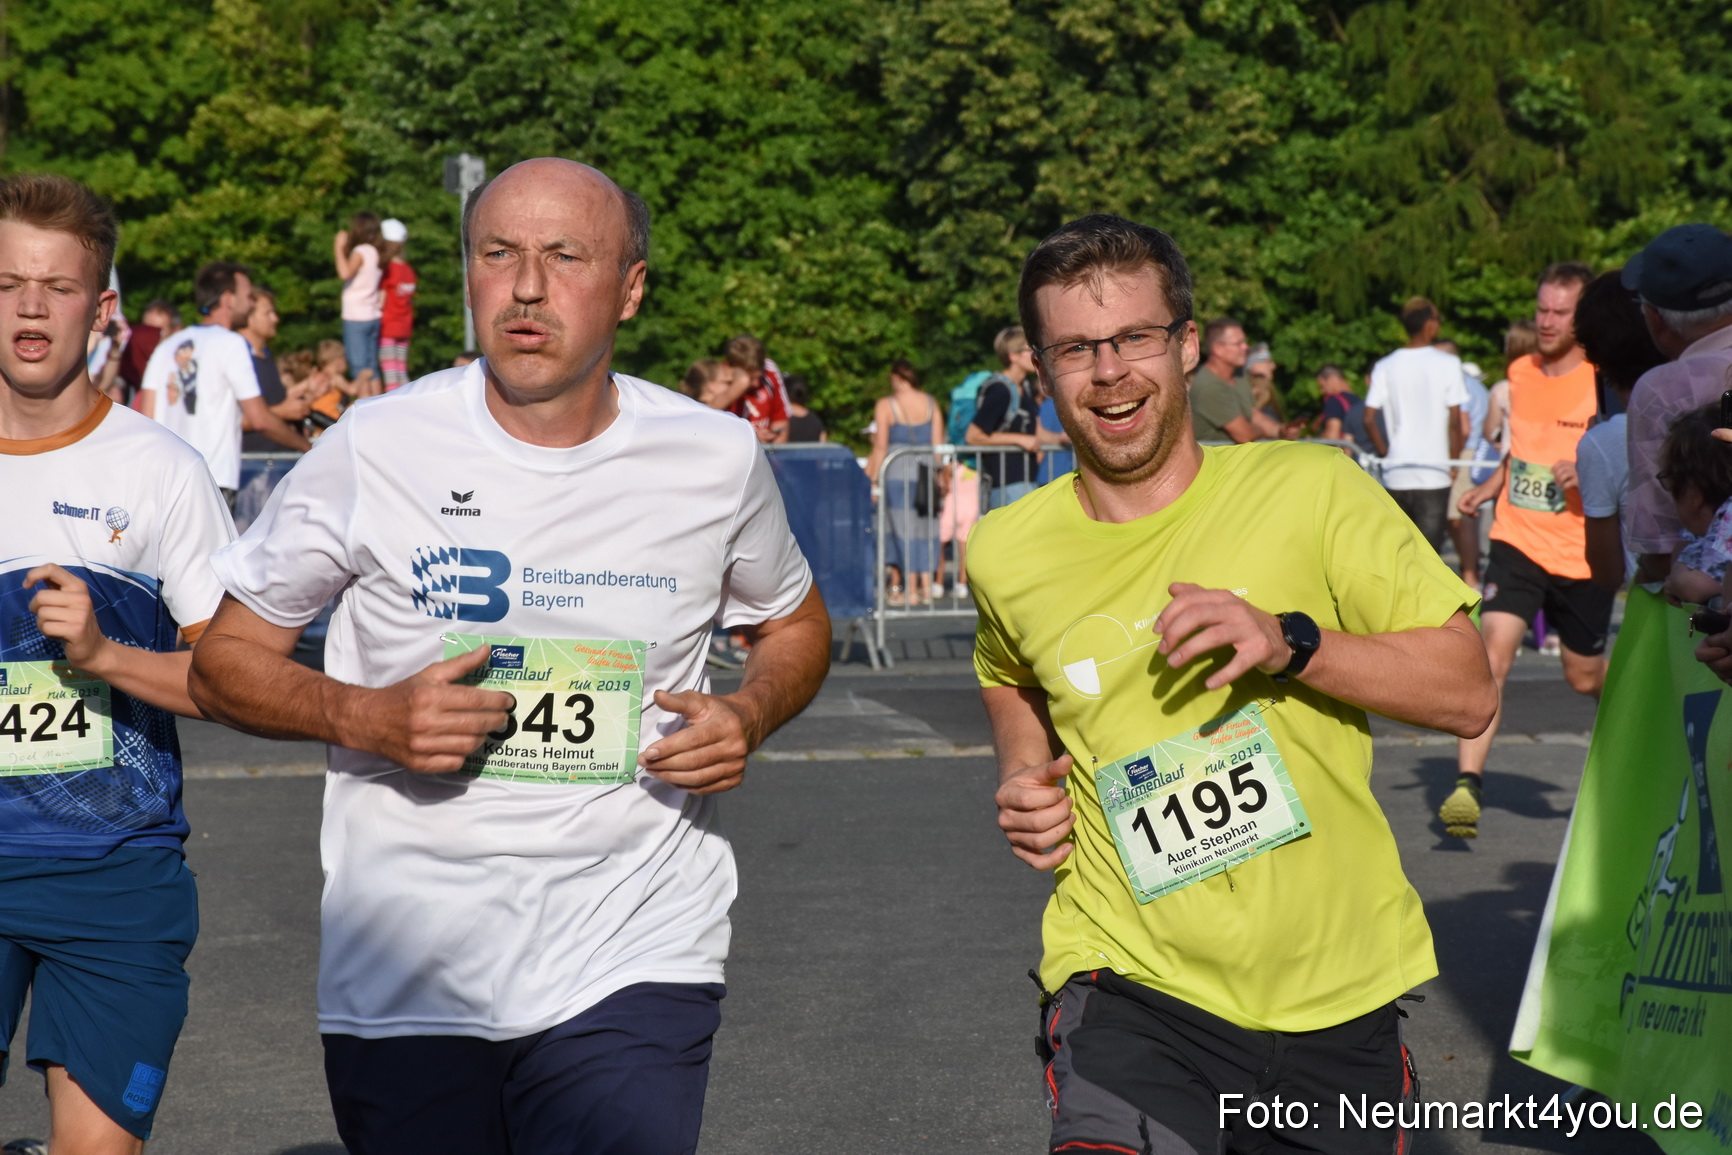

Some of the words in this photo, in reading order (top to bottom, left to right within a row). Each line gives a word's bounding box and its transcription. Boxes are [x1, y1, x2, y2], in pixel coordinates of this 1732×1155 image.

[1513, 475, 1557, 499] 2285
[441, 506, 481, 517] erima
[522, 568, 677, 593] Breitbandberatung
[522, 590, 584, 611] Bayern
[71, 687, 100, 698] 2019
[596, 680, 631, 692] 2019
[484, 743, 538, 759] Kobras
[543, 746, 595, 760] Helmut
[1230, 742, 1262, 766] 2019
[551, 762, 586, 773] Bayern
[589, 762, 620, 772] GmbH
[1122, 763, 1185, 802] firmenlauf
[1131, 762, 1268, 855] 1195
[1166, 845, 1198, 866] Auer
[1200, 819, 1258, 852] Stephan
[1173, 853, 1215, 876] Klinikum
[1214, 832, 1261, 858] Neumarkt
